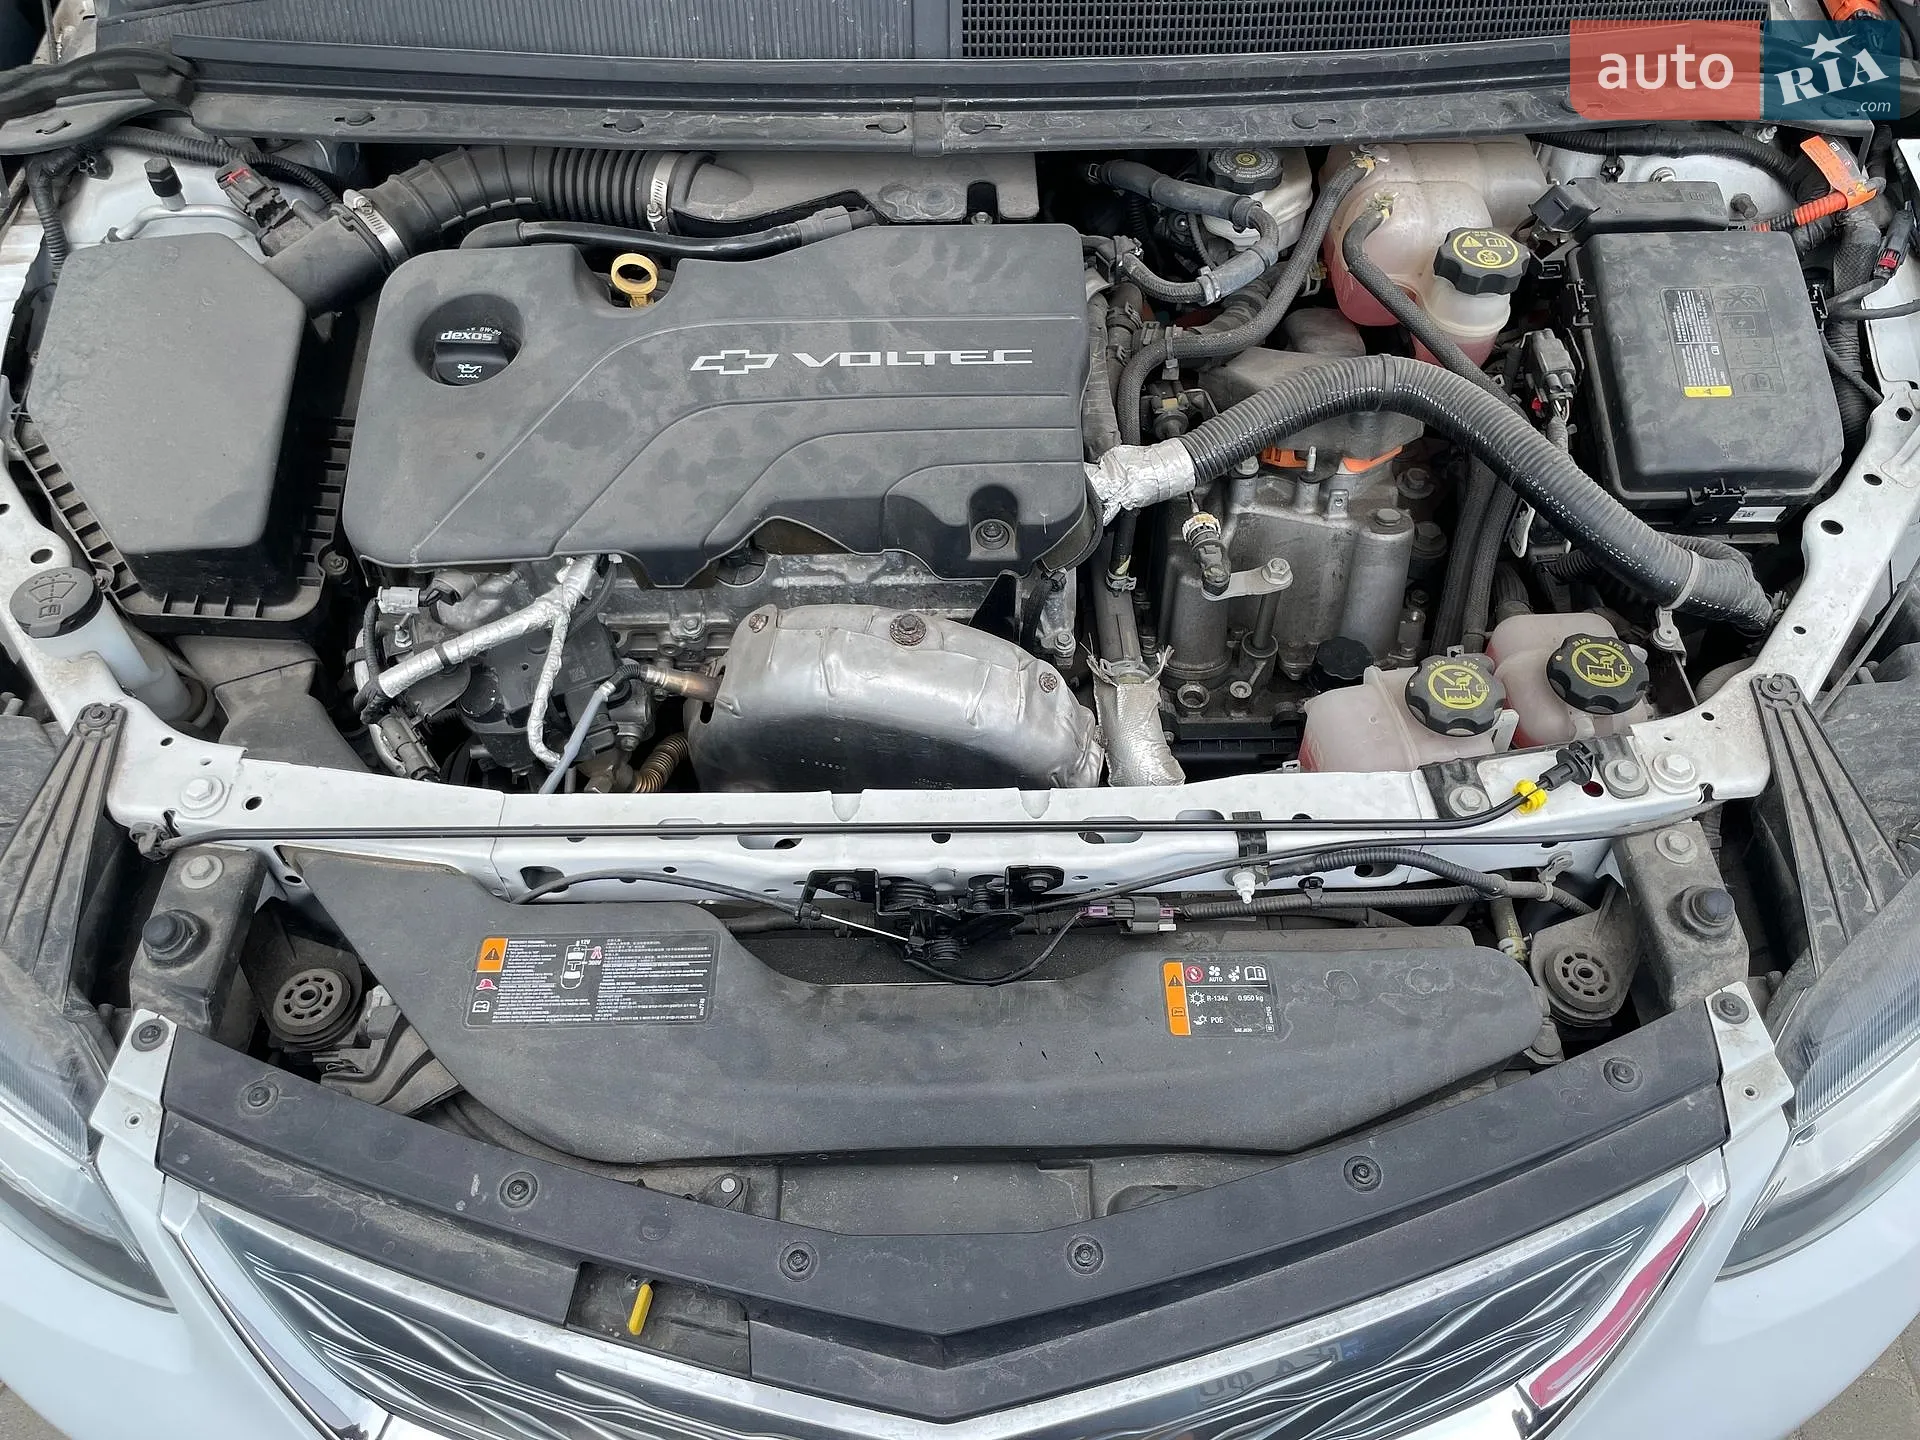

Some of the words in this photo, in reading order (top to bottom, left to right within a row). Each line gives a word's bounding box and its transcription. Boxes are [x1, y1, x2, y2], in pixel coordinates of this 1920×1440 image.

[441, 330, 492, 340] dexos
[792, 349, 1033, 367] VOLTEC
[1237, 994, 1255, 1002] 0.950
[1255, 994, 1264, 1003] kg
